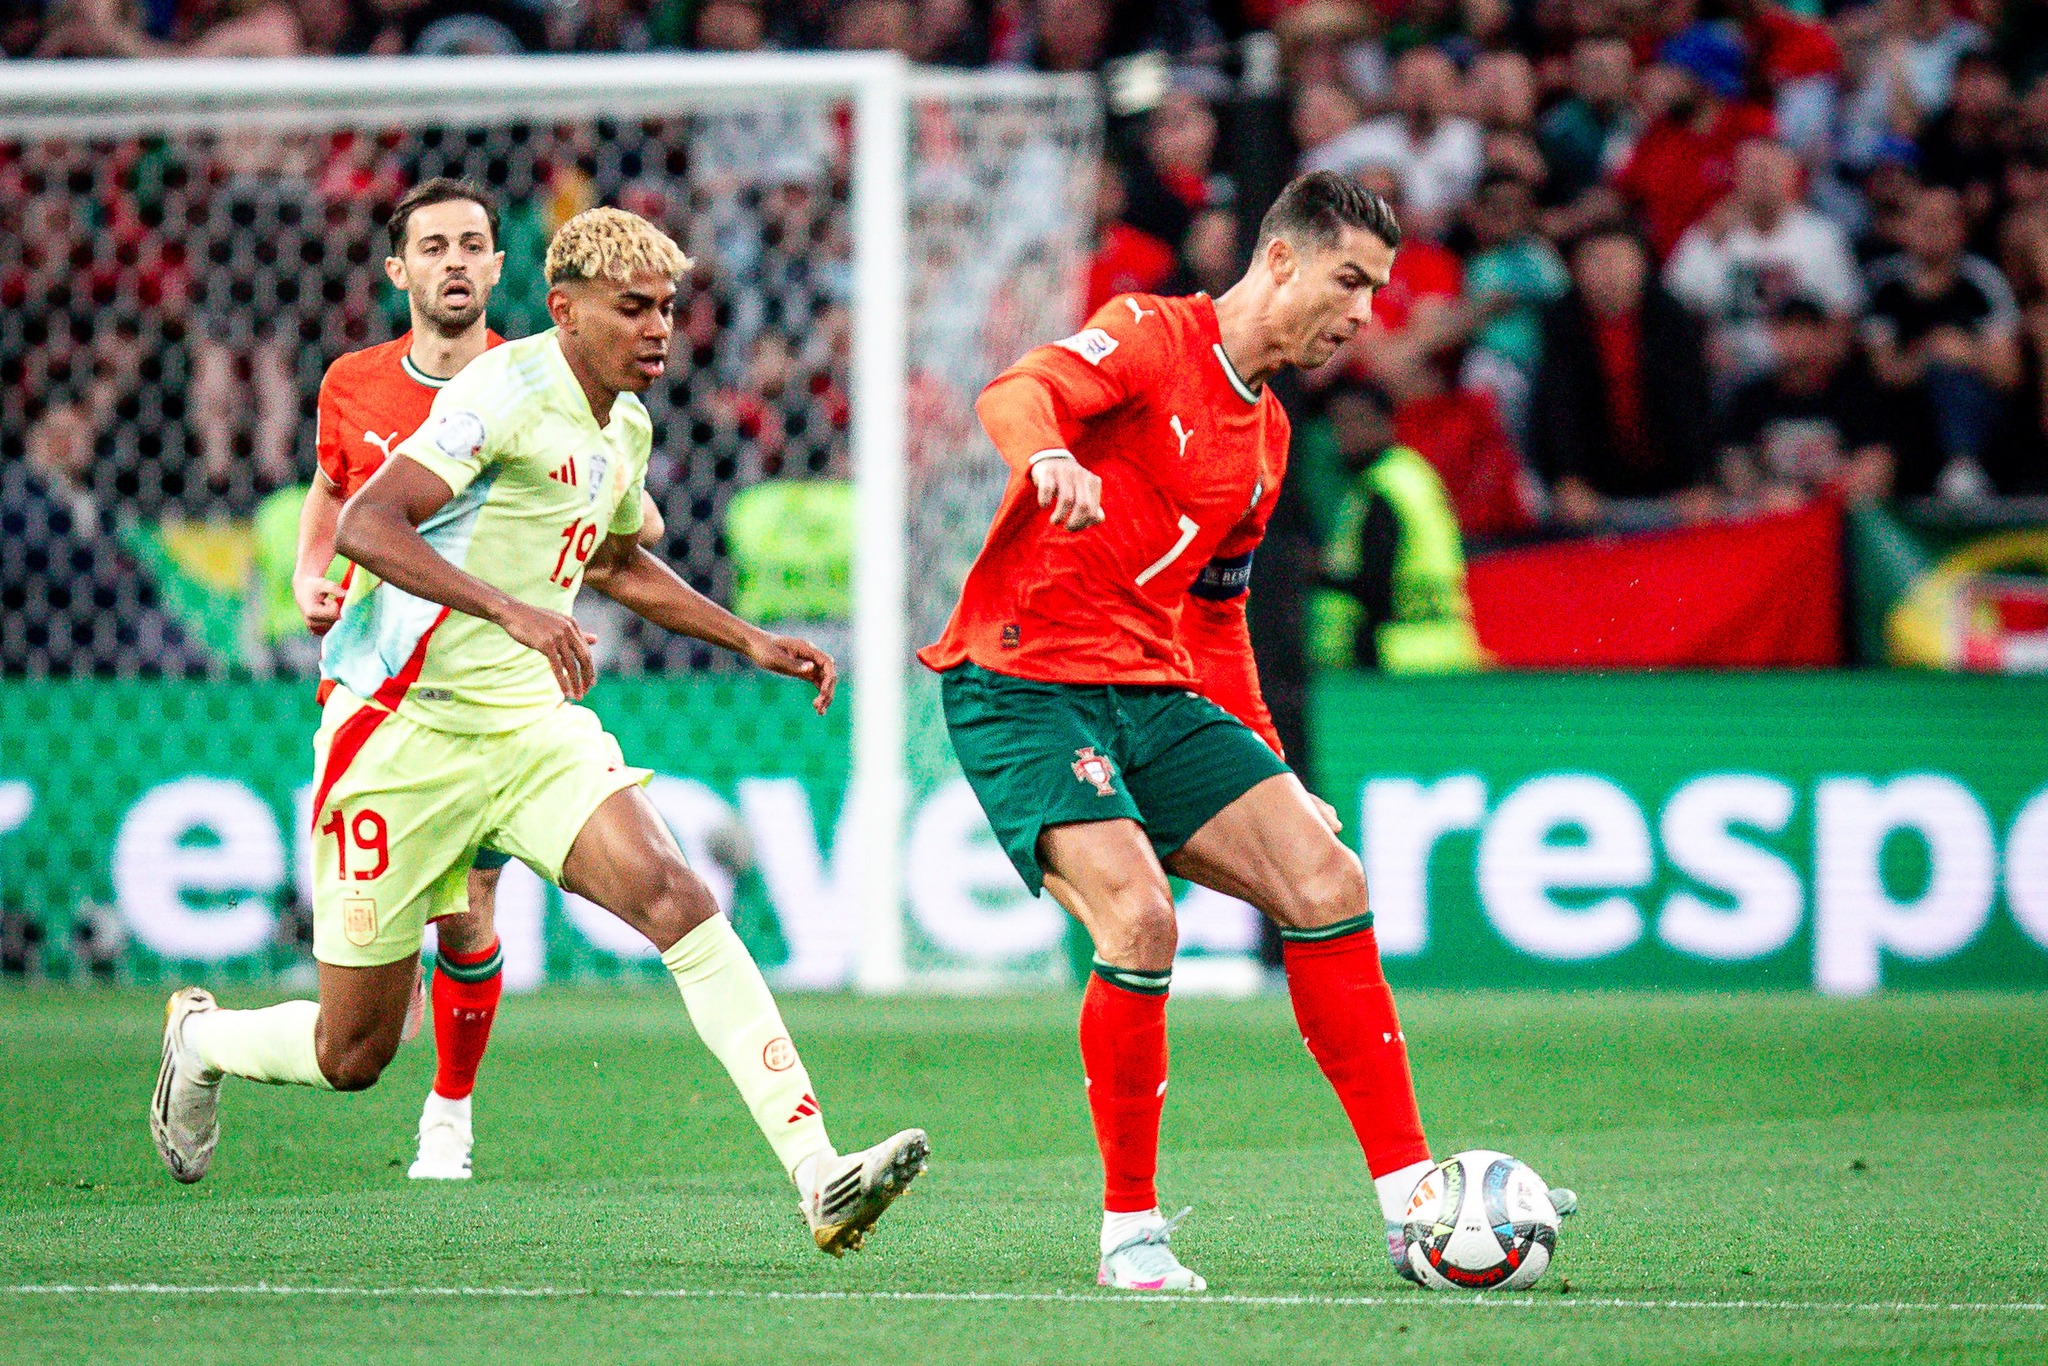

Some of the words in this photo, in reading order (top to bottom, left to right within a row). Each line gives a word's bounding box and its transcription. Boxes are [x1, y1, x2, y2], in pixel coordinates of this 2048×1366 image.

[549, 517, 598, 589] 19
[1134, 514, 1200, 587] 7
[322, 808, 389, 880] 19
[1361, 772, 2048, 996] resp
